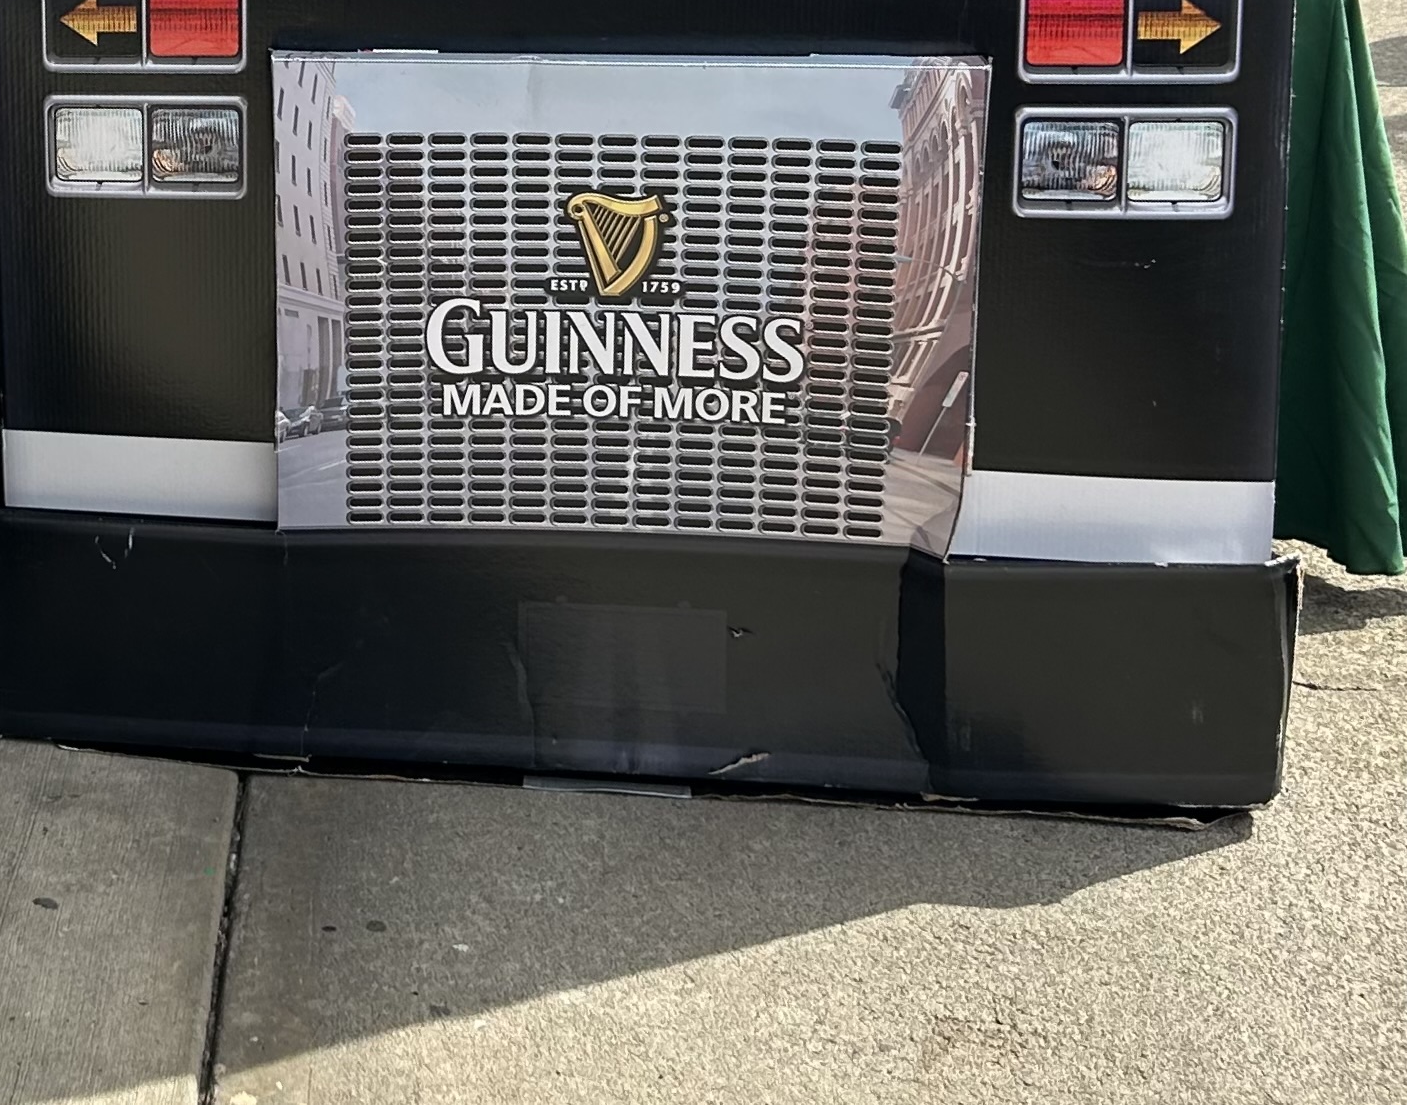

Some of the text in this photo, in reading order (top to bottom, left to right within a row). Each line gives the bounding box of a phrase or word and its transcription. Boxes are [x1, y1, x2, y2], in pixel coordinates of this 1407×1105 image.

[642, 281, 680, 293] 1759
[426, 298, 804, 383] GUINNESS
[443, 384, 786, 424] MADE OF MORE
